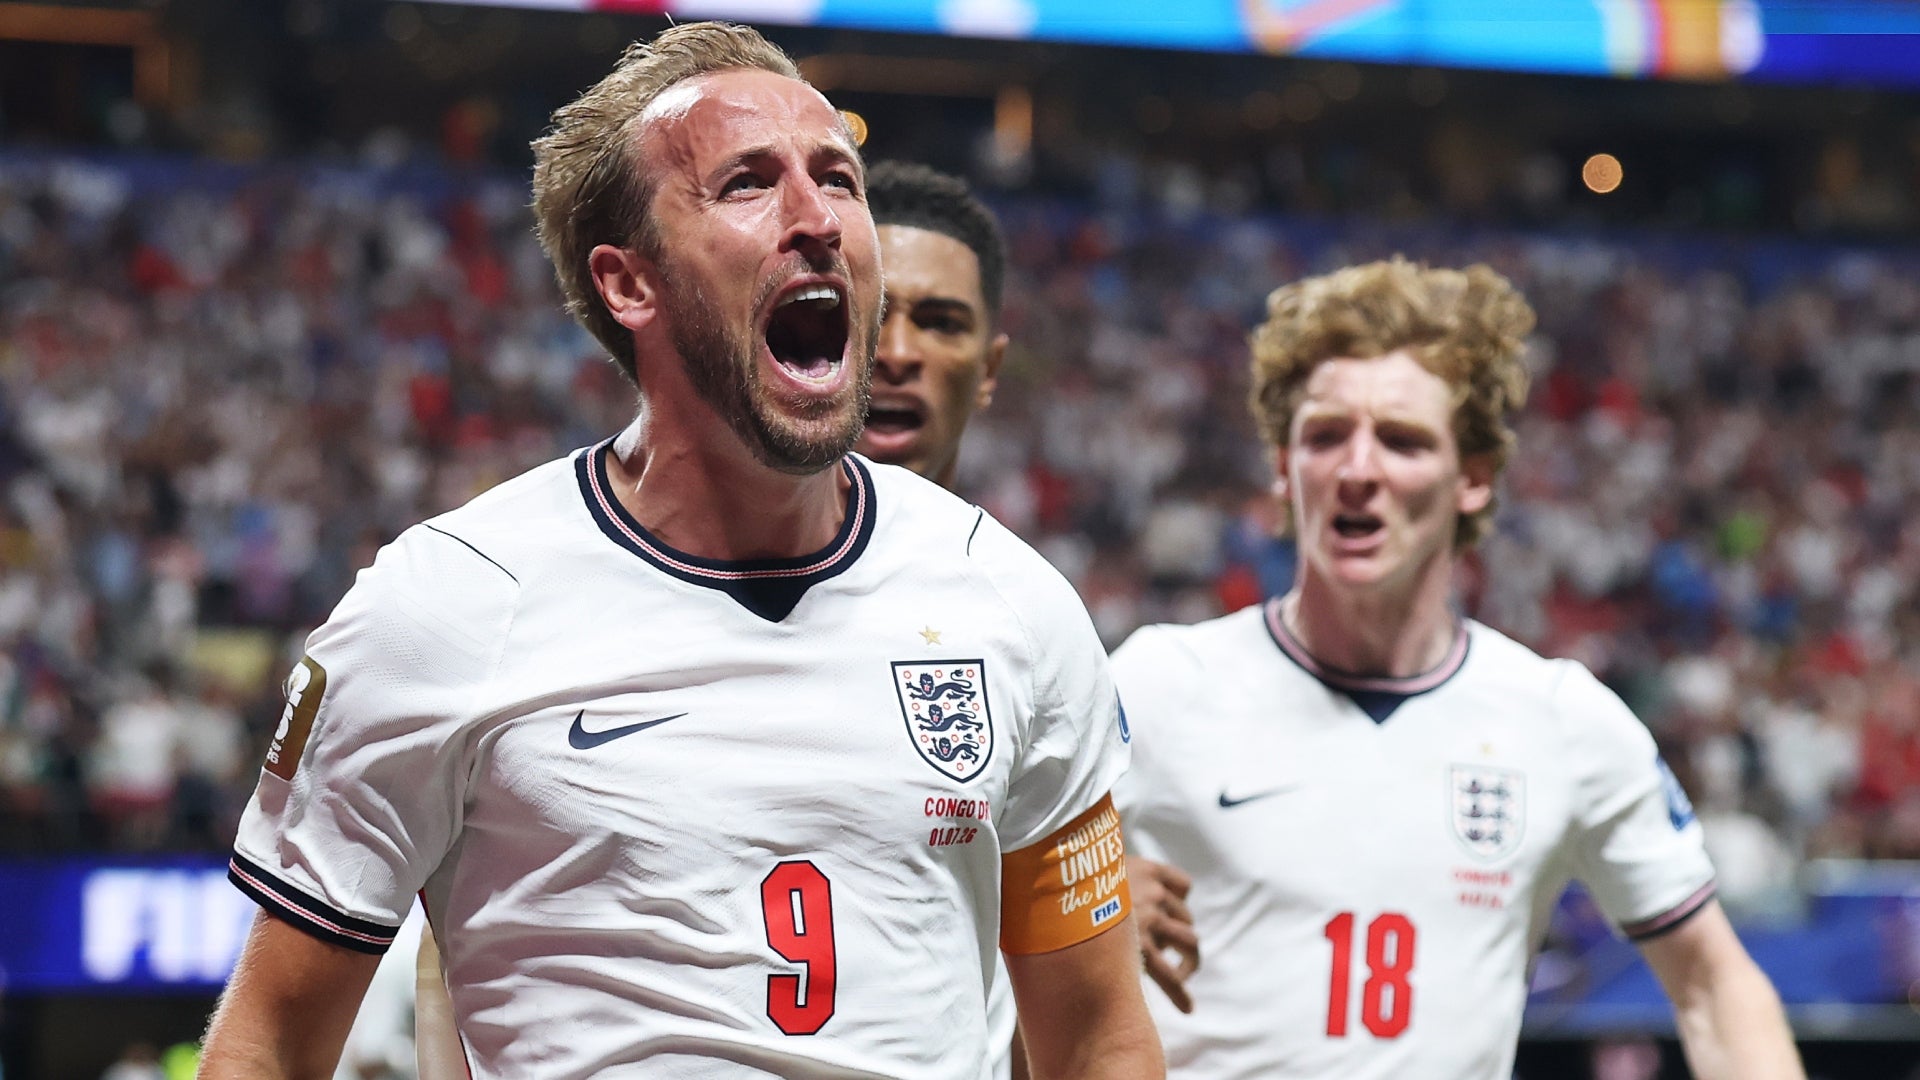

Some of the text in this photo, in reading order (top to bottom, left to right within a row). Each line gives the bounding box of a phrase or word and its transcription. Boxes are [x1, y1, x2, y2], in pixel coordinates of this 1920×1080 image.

[924, 797, 976, 818] CONGO
[929, 827, 978, 847] 01.07.26
[1057, 806, 1119, 858] FOOTBALL
[1060, 827, 1124, 886] UNITES
[1058, 886, 1093, 915] the
[1094, 901, 1119, 922] FIFA
[761, 860, 837, 1036] 9
[1324, 912, 1416, 1038] 18
